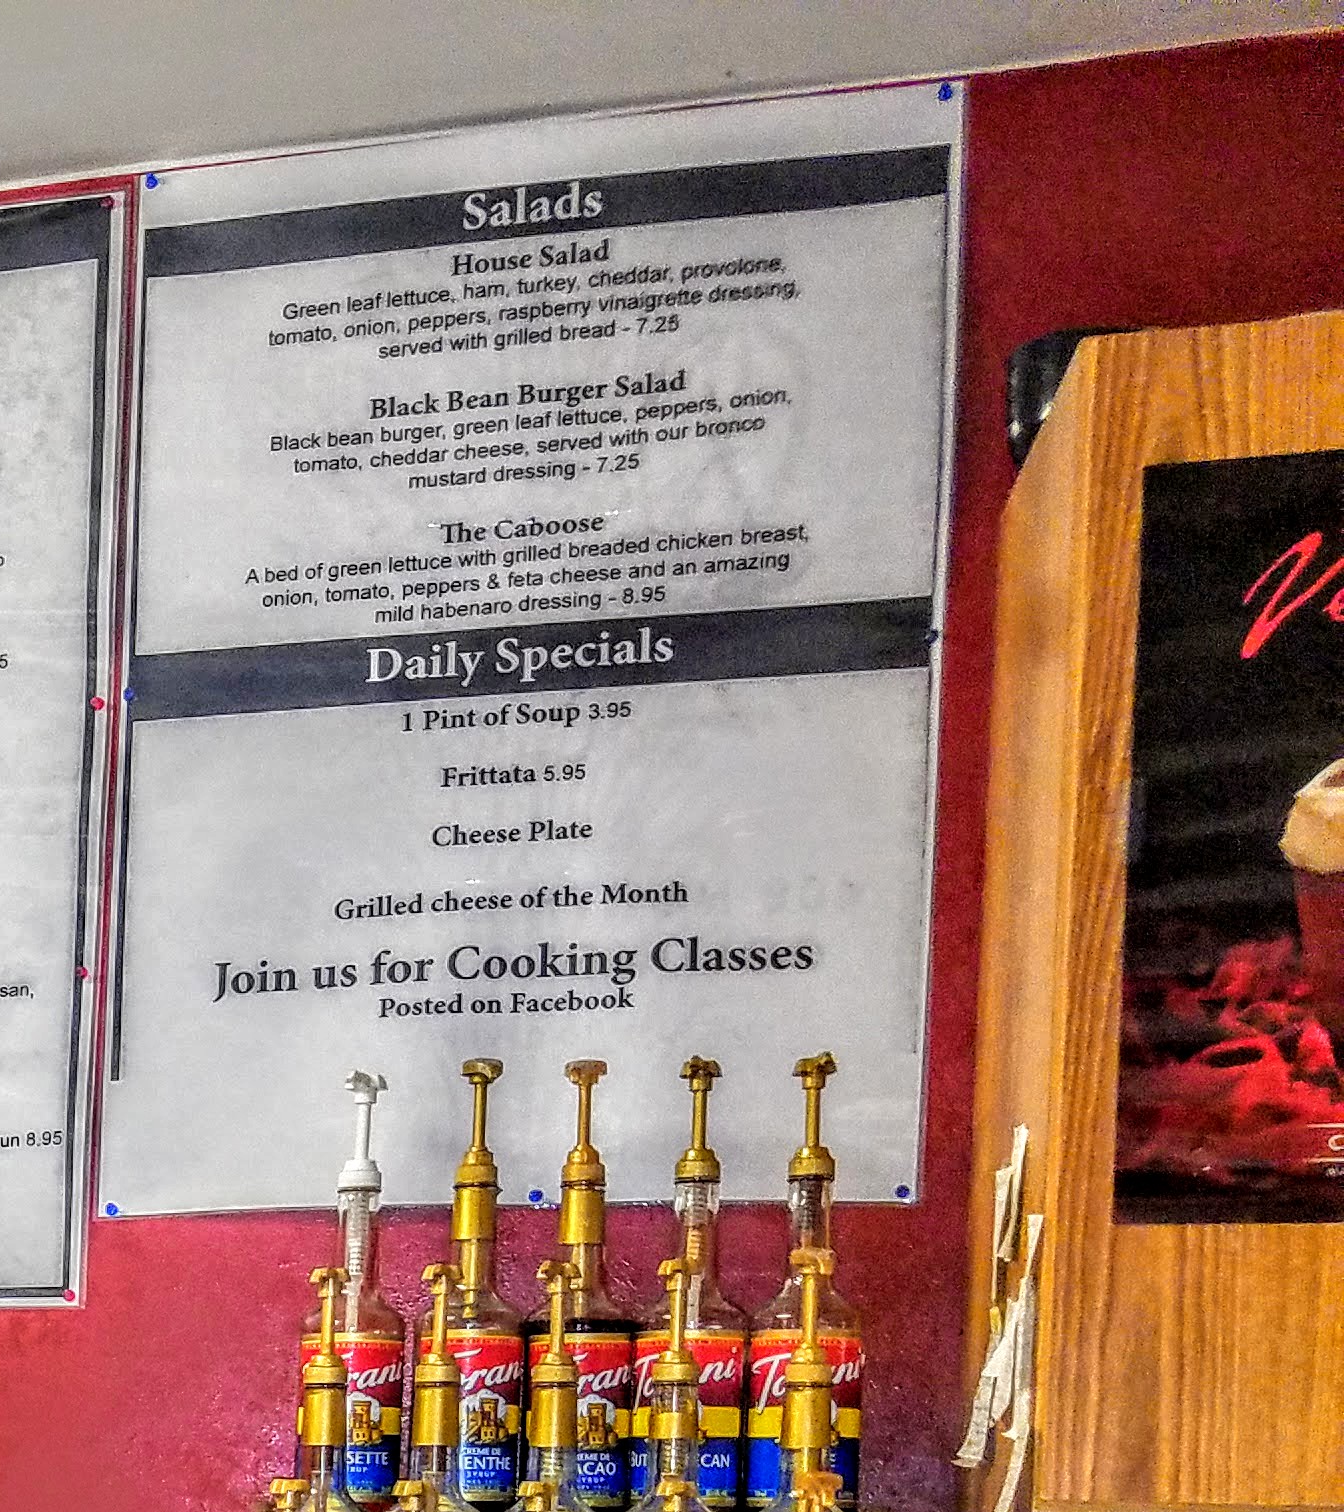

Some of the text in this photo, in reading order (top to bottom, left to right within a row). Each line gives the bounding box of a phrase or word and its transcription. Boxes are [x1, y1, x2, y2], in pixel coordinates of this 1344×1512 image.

[463, 182, 603, 229] Salads
[451, 238, 609, 276] House Salad
[370, 368, 686, 419] Black Bean Burger Salad
[437, 517, 606, 543] The Caboose
[375, 586, 665, 623] mild habenaro dressing 8.95
[366, 627, 673, 687] Daily Specials
[423, 710, 476, 731] Pint
[483, 704, 511, 726] of
[515, 704, 580, 728] Soup
[589, 701, 631, 721] 3.95
[440, 764, 585, 787] Frittata 5.95
[432, 819, 593, 847] Cheese Plate
[335, 881, 689, 919] Grilled cheese of the Month
[213, 936, 815, 1003] Join us for Cooking Classes
[378, 987, 635, 1018] Posted on Facebook
[26, 1131, 62, 1146] 8.95
